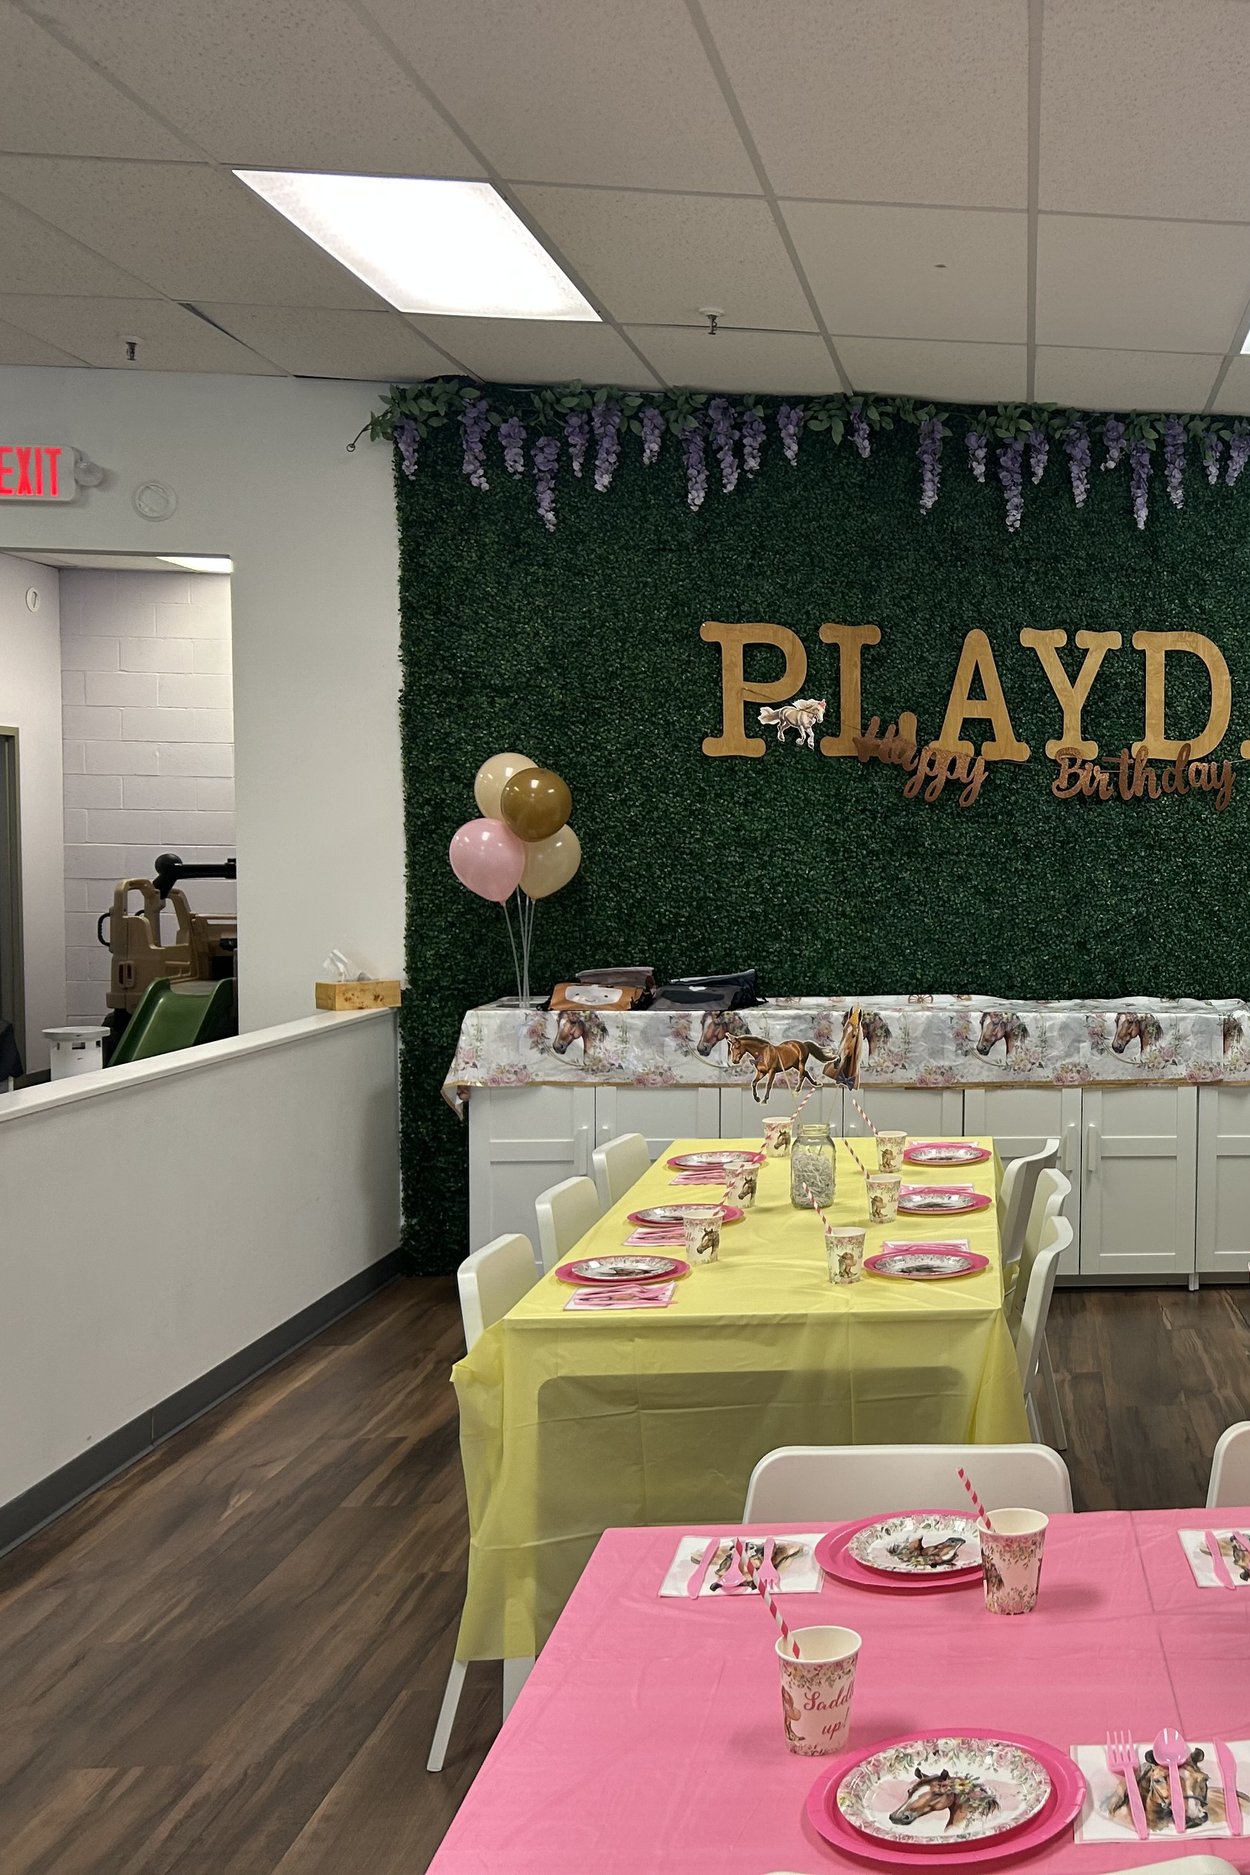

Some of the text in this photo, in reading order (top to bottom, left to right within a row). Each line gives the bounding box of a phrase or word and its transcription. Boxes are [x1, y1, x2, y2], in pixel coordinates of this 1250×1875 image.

[0, 445, 62, 497] EXIT
[852, 715, 1236, 811] Happy Birthday
[803, 1680, 855, 1711] Saddl
[821, 1706, 850, 1740] up!
